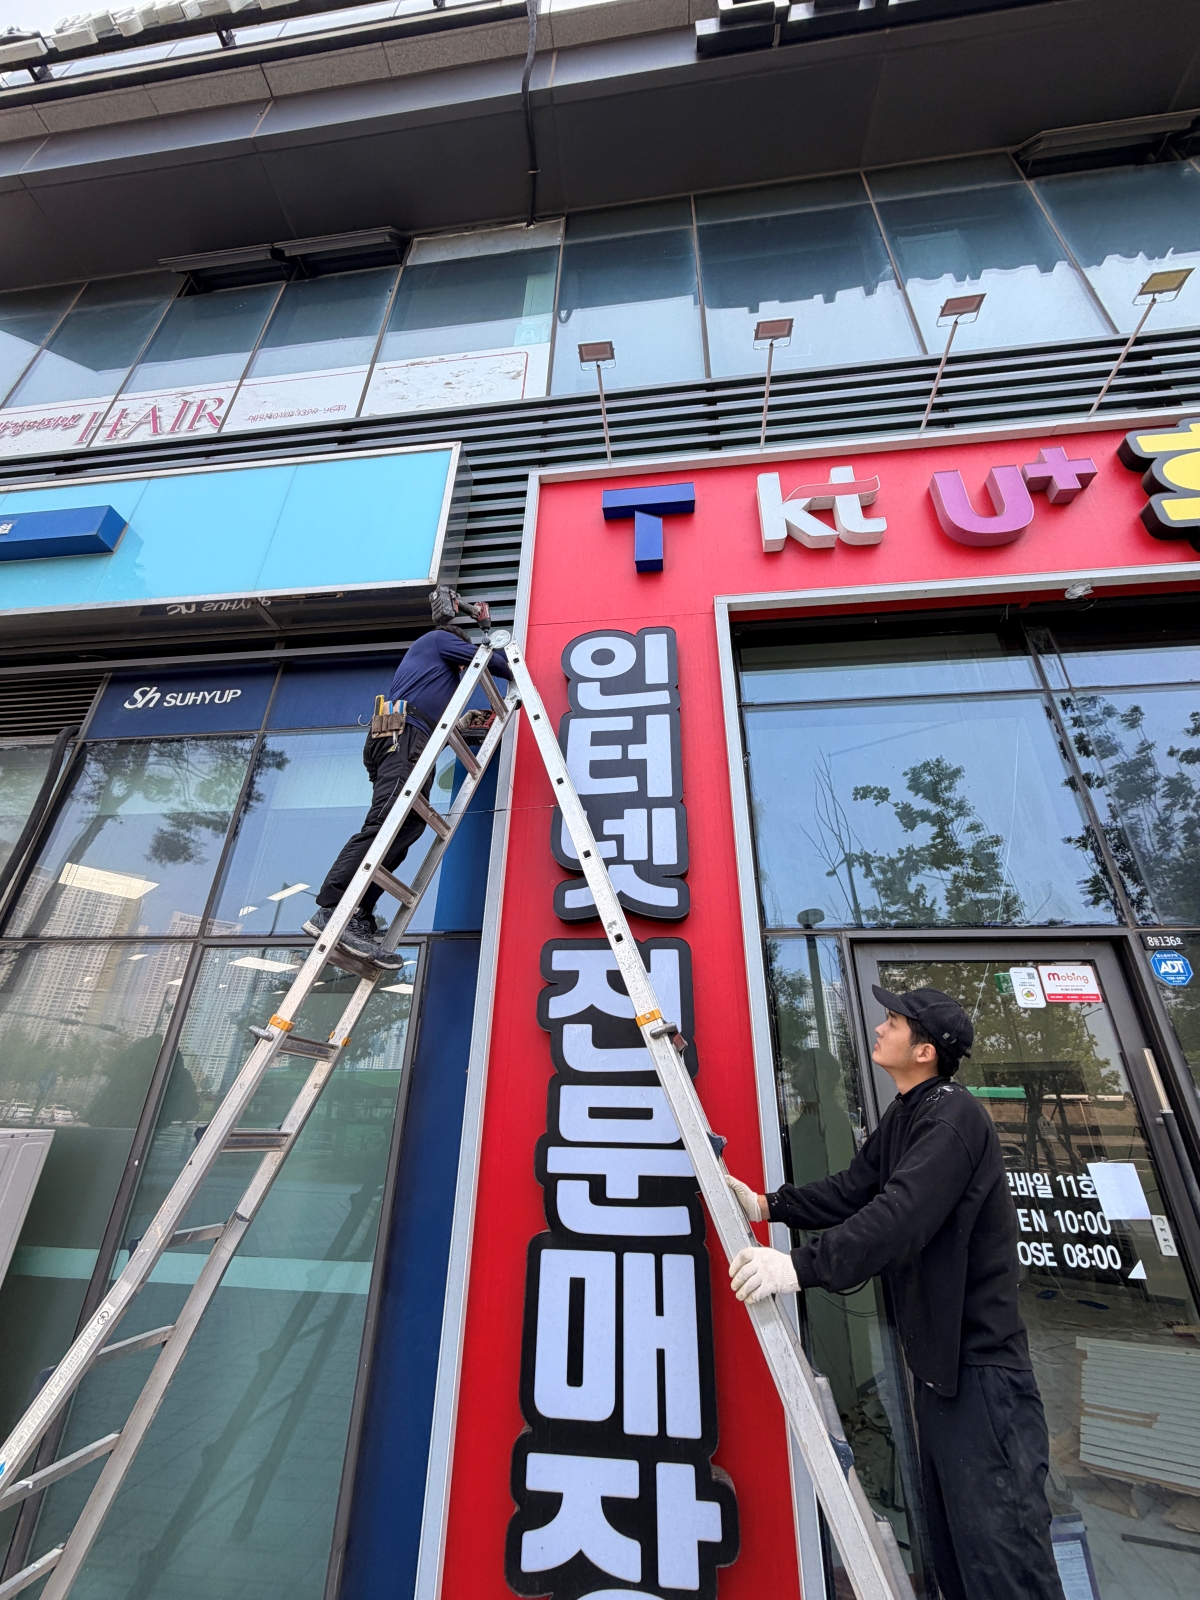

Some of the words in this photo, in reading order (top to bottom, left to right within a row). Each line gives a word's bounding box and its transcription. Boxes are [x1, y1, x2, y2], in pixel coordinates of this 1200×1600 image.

[77, 397, 224, 442] HAIR
[603, 482, 695, 572] T
[757, 466, 887, 553] kt
[124, 687, 161, 708] Sh
[163, 689, 241, 707] SUHYUP
[560, 632, 679, 909] 인터넷
[1160, 960, 1184, 973] ADT
[1016, 1208, 1049, 1233] EN
[1053, 1209, 1112, 1235] 10:00
[1016, 1241, 1058, 1267] OSE
[1062, 1243, 1122, 1270] 08:00
